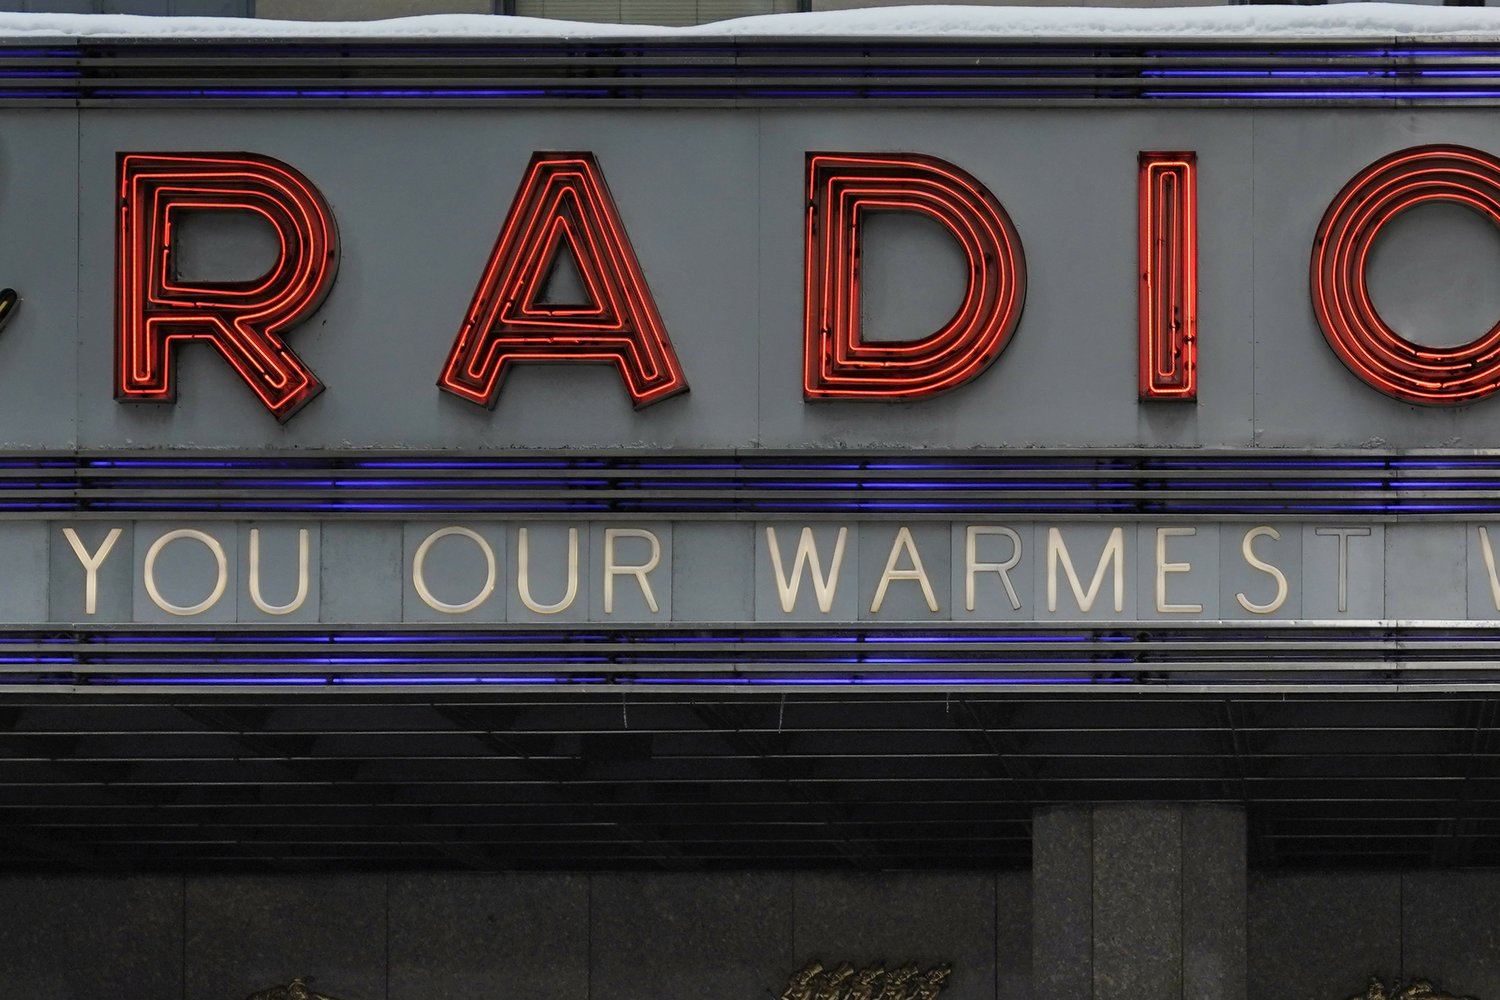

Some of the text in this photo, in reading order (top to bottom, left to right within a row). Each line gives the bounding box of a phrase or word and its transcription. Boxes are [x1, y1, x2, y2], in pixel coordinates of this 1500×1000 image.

[62, 527, 310, 616] YOU
[412, 526, 661, 614] OUR
[766, 525, 1372, 614] WARMEST
